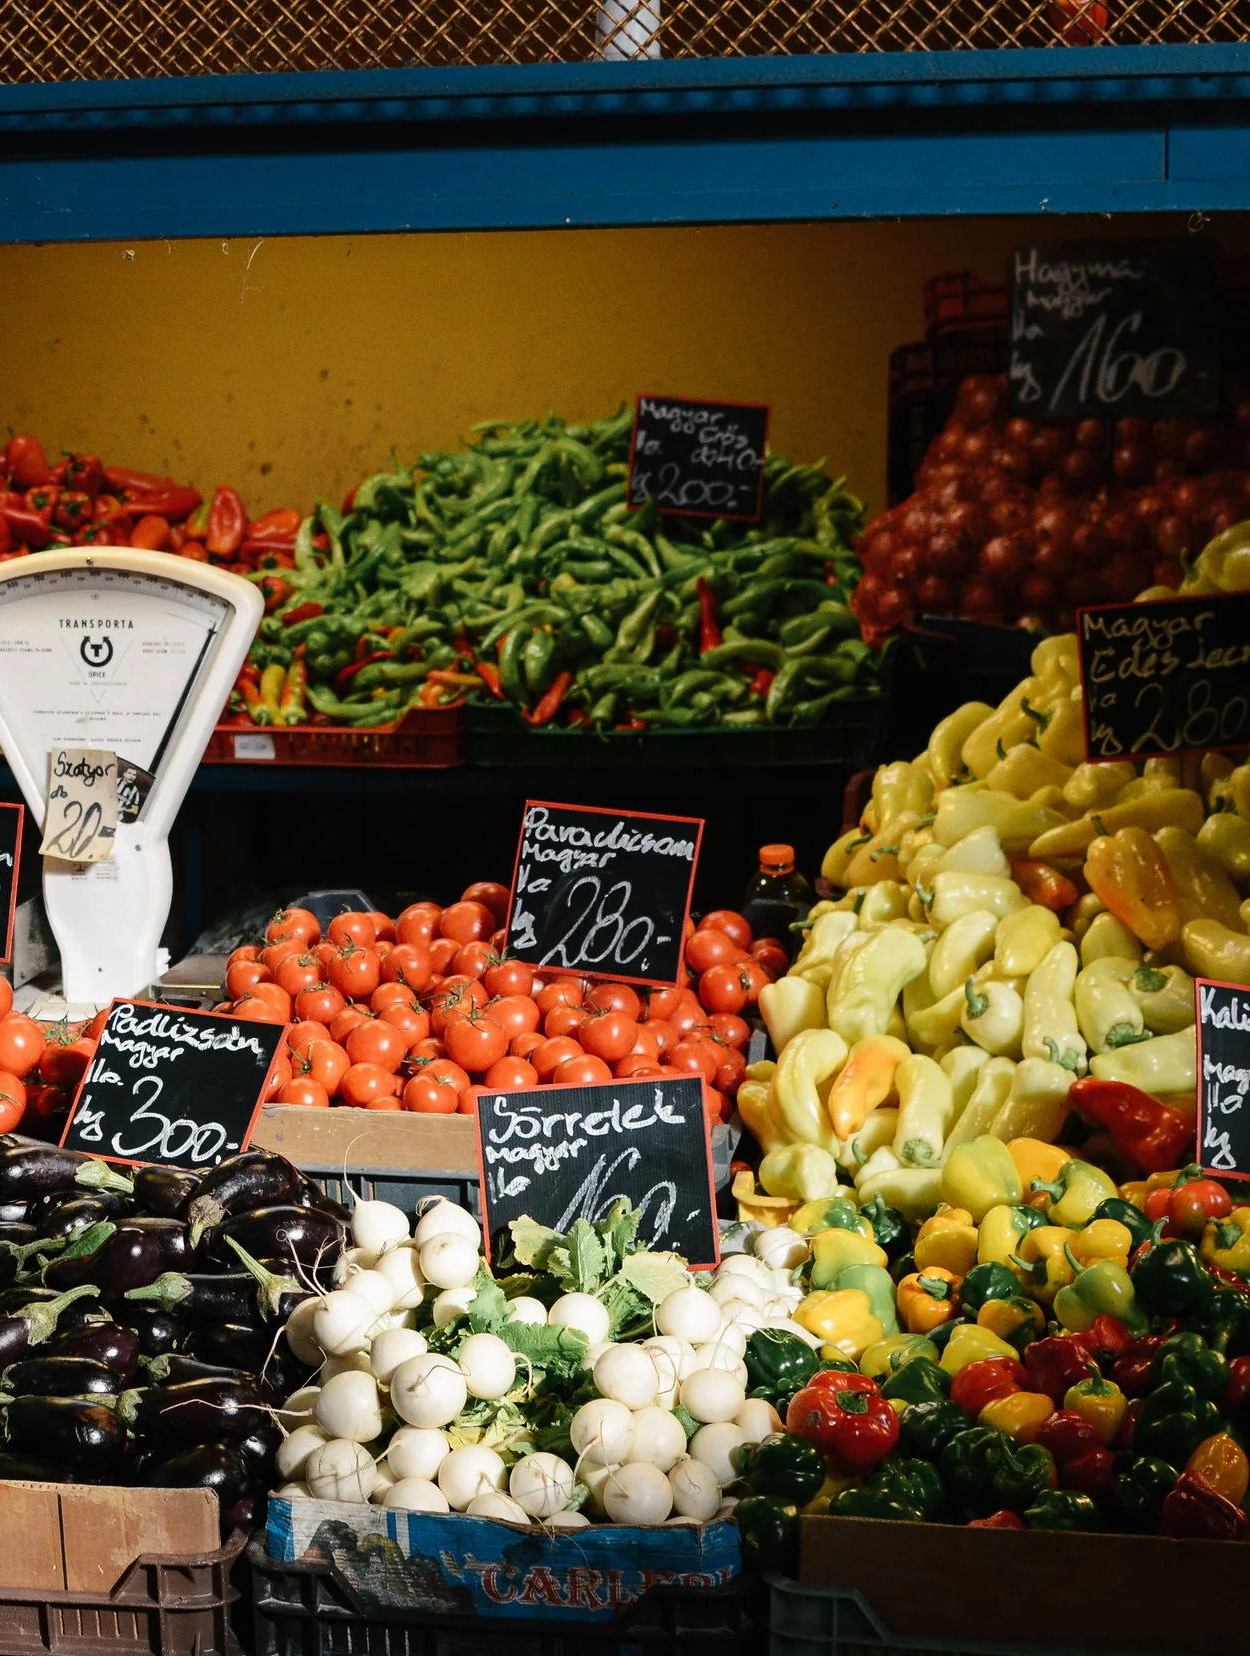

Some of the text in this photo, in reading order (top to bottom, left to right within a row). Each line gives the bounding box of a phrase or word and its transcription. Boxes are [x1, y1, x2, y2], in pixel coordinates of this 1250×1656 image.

[59, 619, 134, 629] TRANSPORTA
[1083, 610, 1216, 650] Magyar
[54, 751, 115, 787] Szatyor
[50, 785, 68, 799] db
[511, 898, 537, 949] kg
[73, 1095, 105, 1141] kg
[1204, 1116, 1236, 1170] kg
